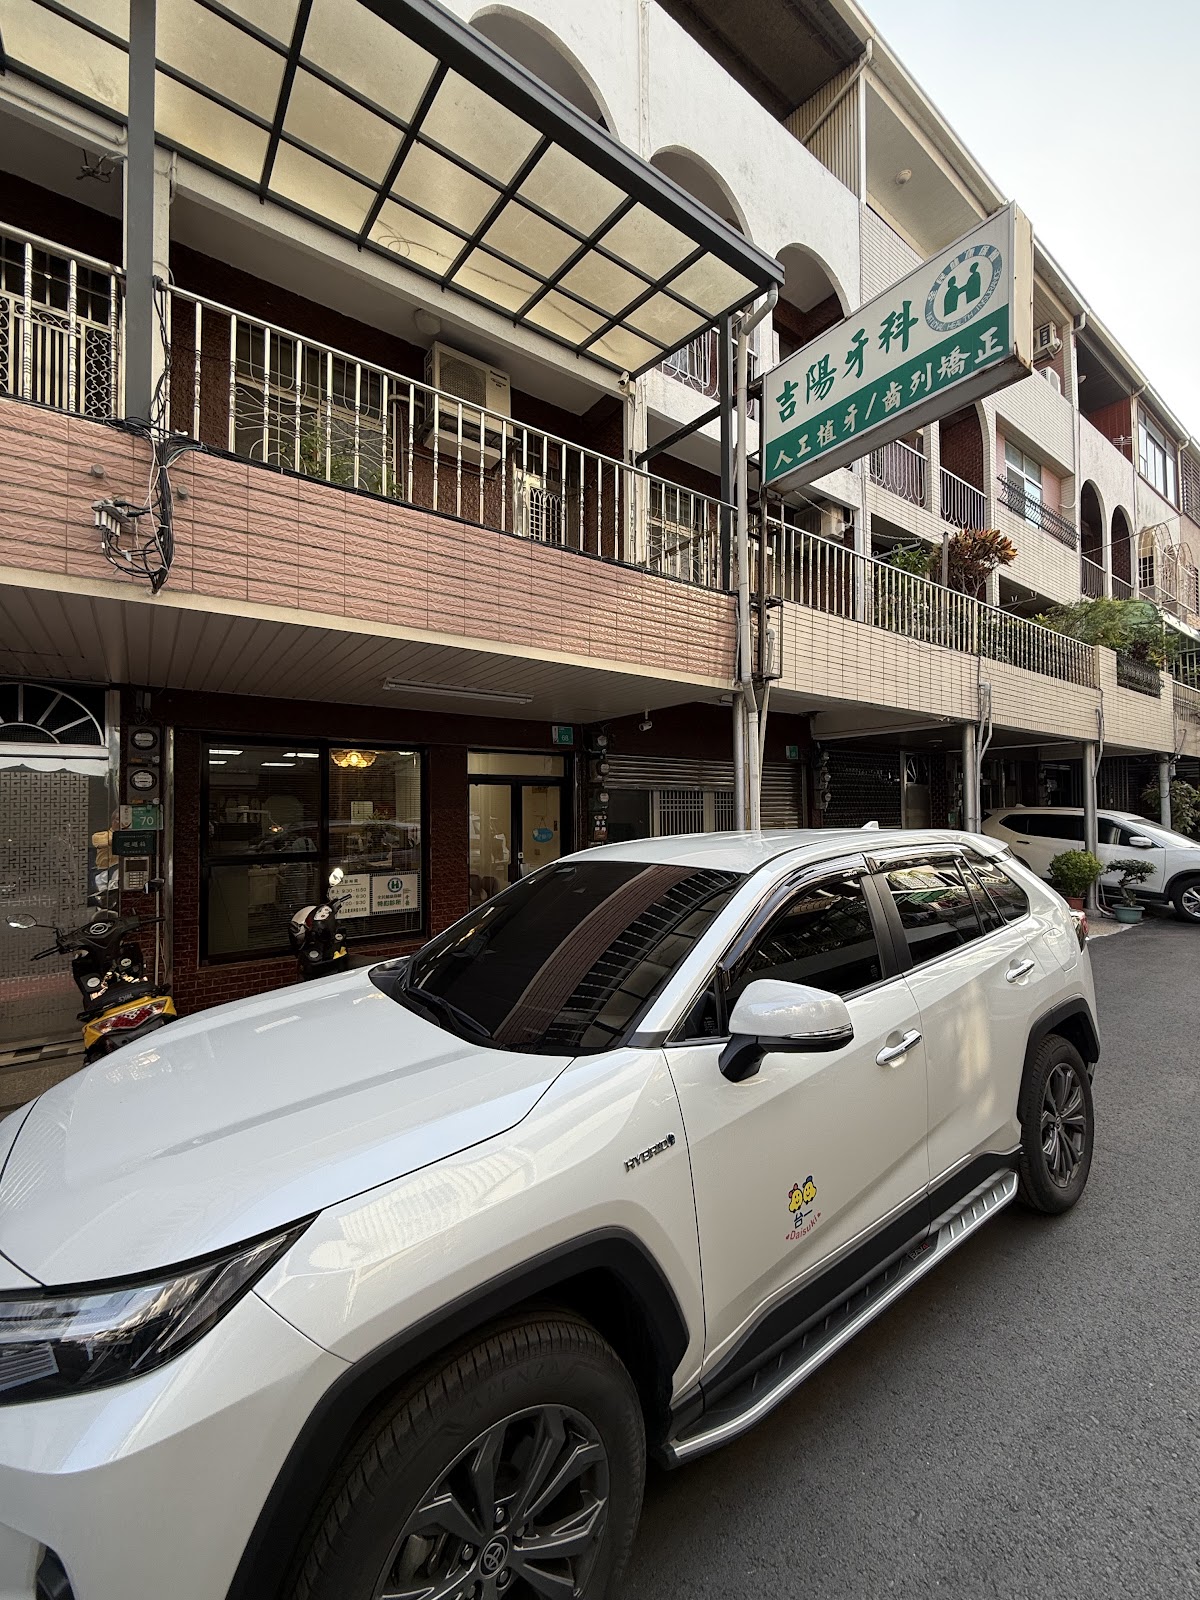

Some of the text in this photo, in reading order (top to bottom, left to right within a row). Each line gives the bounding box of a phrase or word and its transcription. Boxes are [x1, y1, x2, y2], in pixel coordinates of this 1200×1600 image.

[775, 301, 919, 423] 吉陽牙科
[139, 816, 154, 826] 70
[624, 1137, 670, 1173] HYBRID
[789, 1214, 818, 1240] Daisuki
